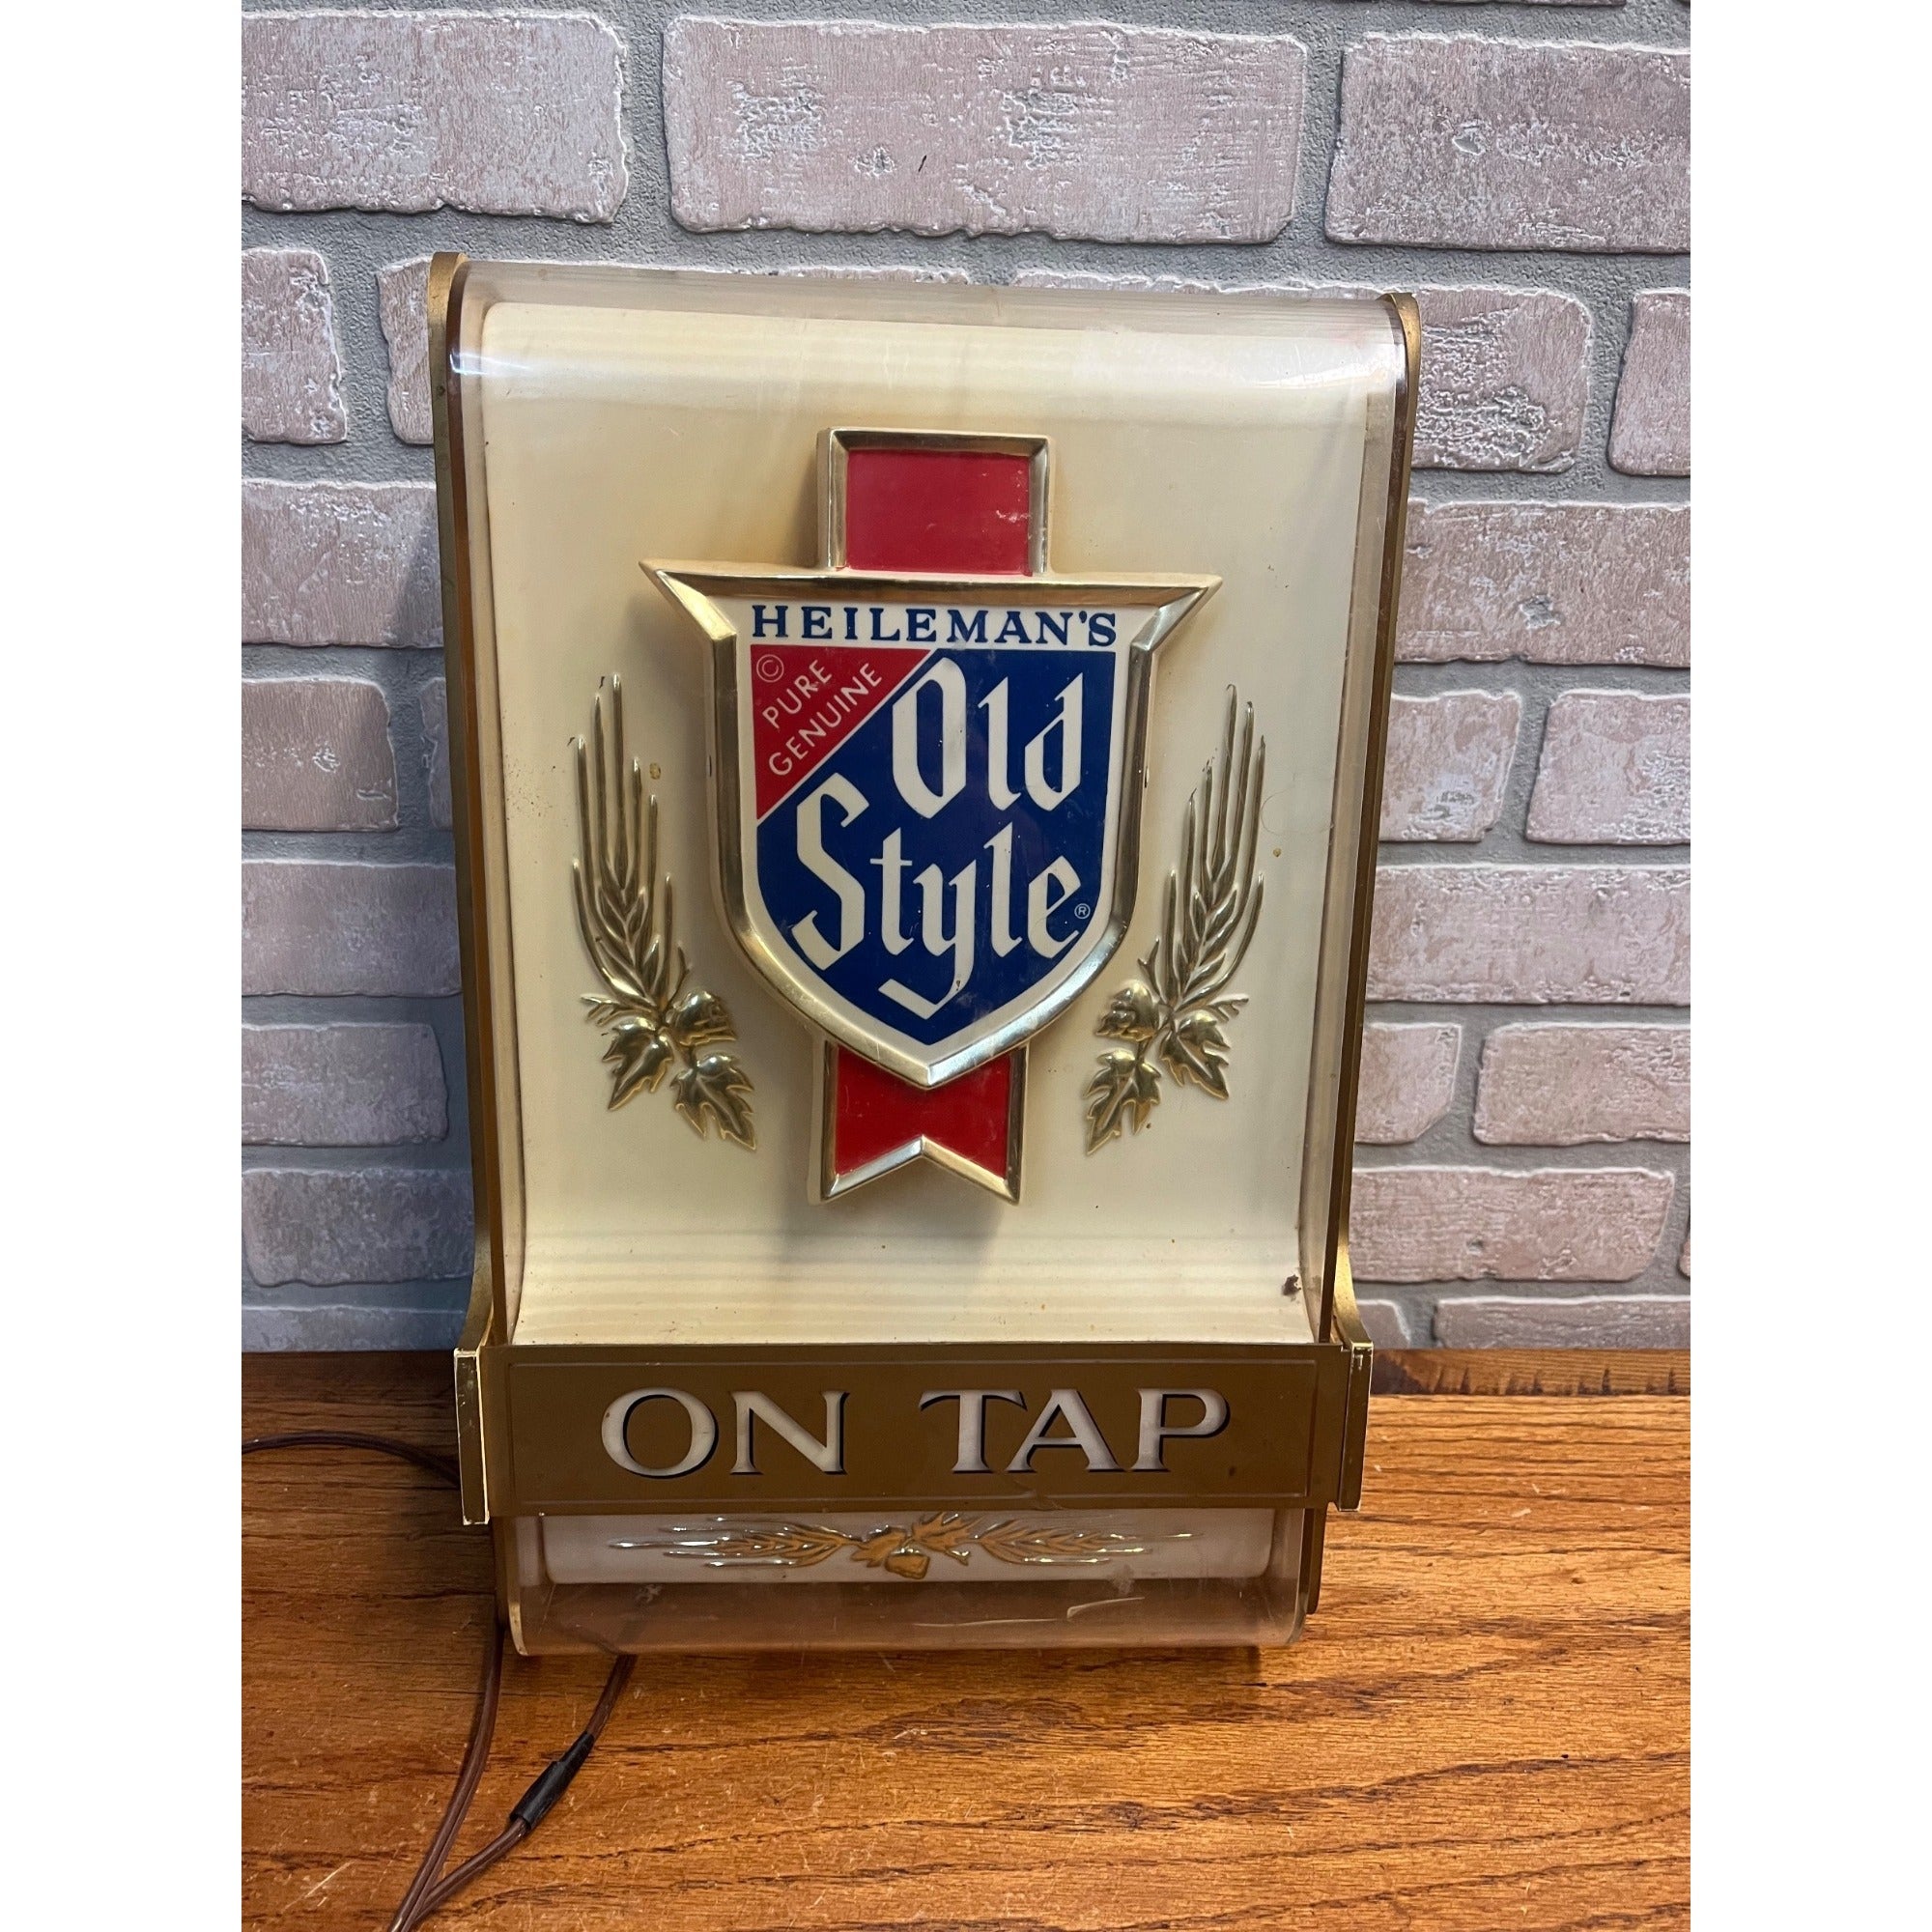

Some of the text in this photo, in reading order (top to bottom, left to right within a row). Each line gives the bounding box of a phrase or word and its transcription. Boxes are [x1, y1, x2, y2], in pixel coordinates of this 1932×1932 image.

[752, 605, 1116, 646] HEILEMAN'S
[762, 660, 832, 727] PURE
[769, 663, 881, 775] GENUINE
[893, 657, 1083, 818] Old
[791, 773, 1081, 1020] Style
[600, 1386, 1231, 1477] ON TAP
